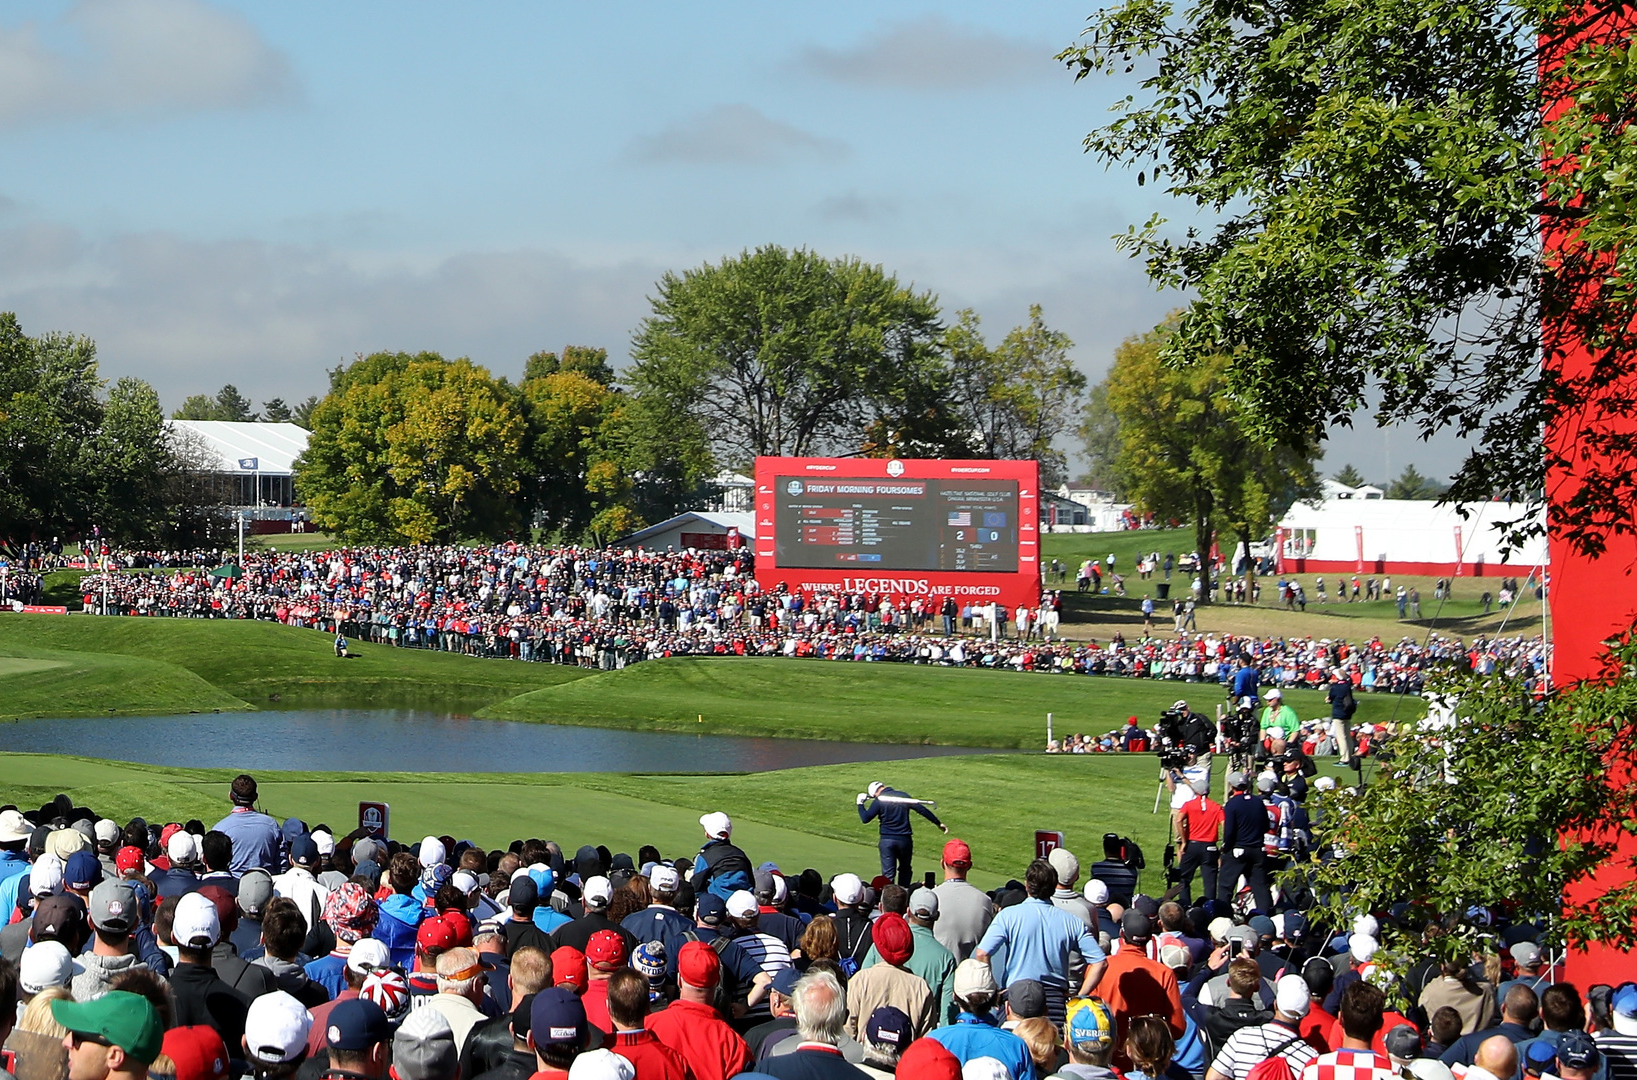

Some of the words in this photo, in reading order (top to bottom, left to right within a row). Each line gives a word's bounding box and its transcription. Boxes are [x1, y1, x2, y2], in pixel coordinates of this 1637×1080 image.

[807, 484, 835, 493] FRIDAY
[837, 485, 874, 494] MORNING
[876, 486, 923, 495] FOURSOMES
[956, 530, 965, 541] 2
[990, 531, 999, 541] 0
[802, 583, 842, 592] WHERE
[844, 578, 928, 595] LEGENDS
[930, 586, 952, 595] ARE
[954, 586, 1001, 596] FORGED
[1040, 840, 1056, 859] 17
[641, 965, 666, 975] RYDER
[23, 982, 43, 992] PING
